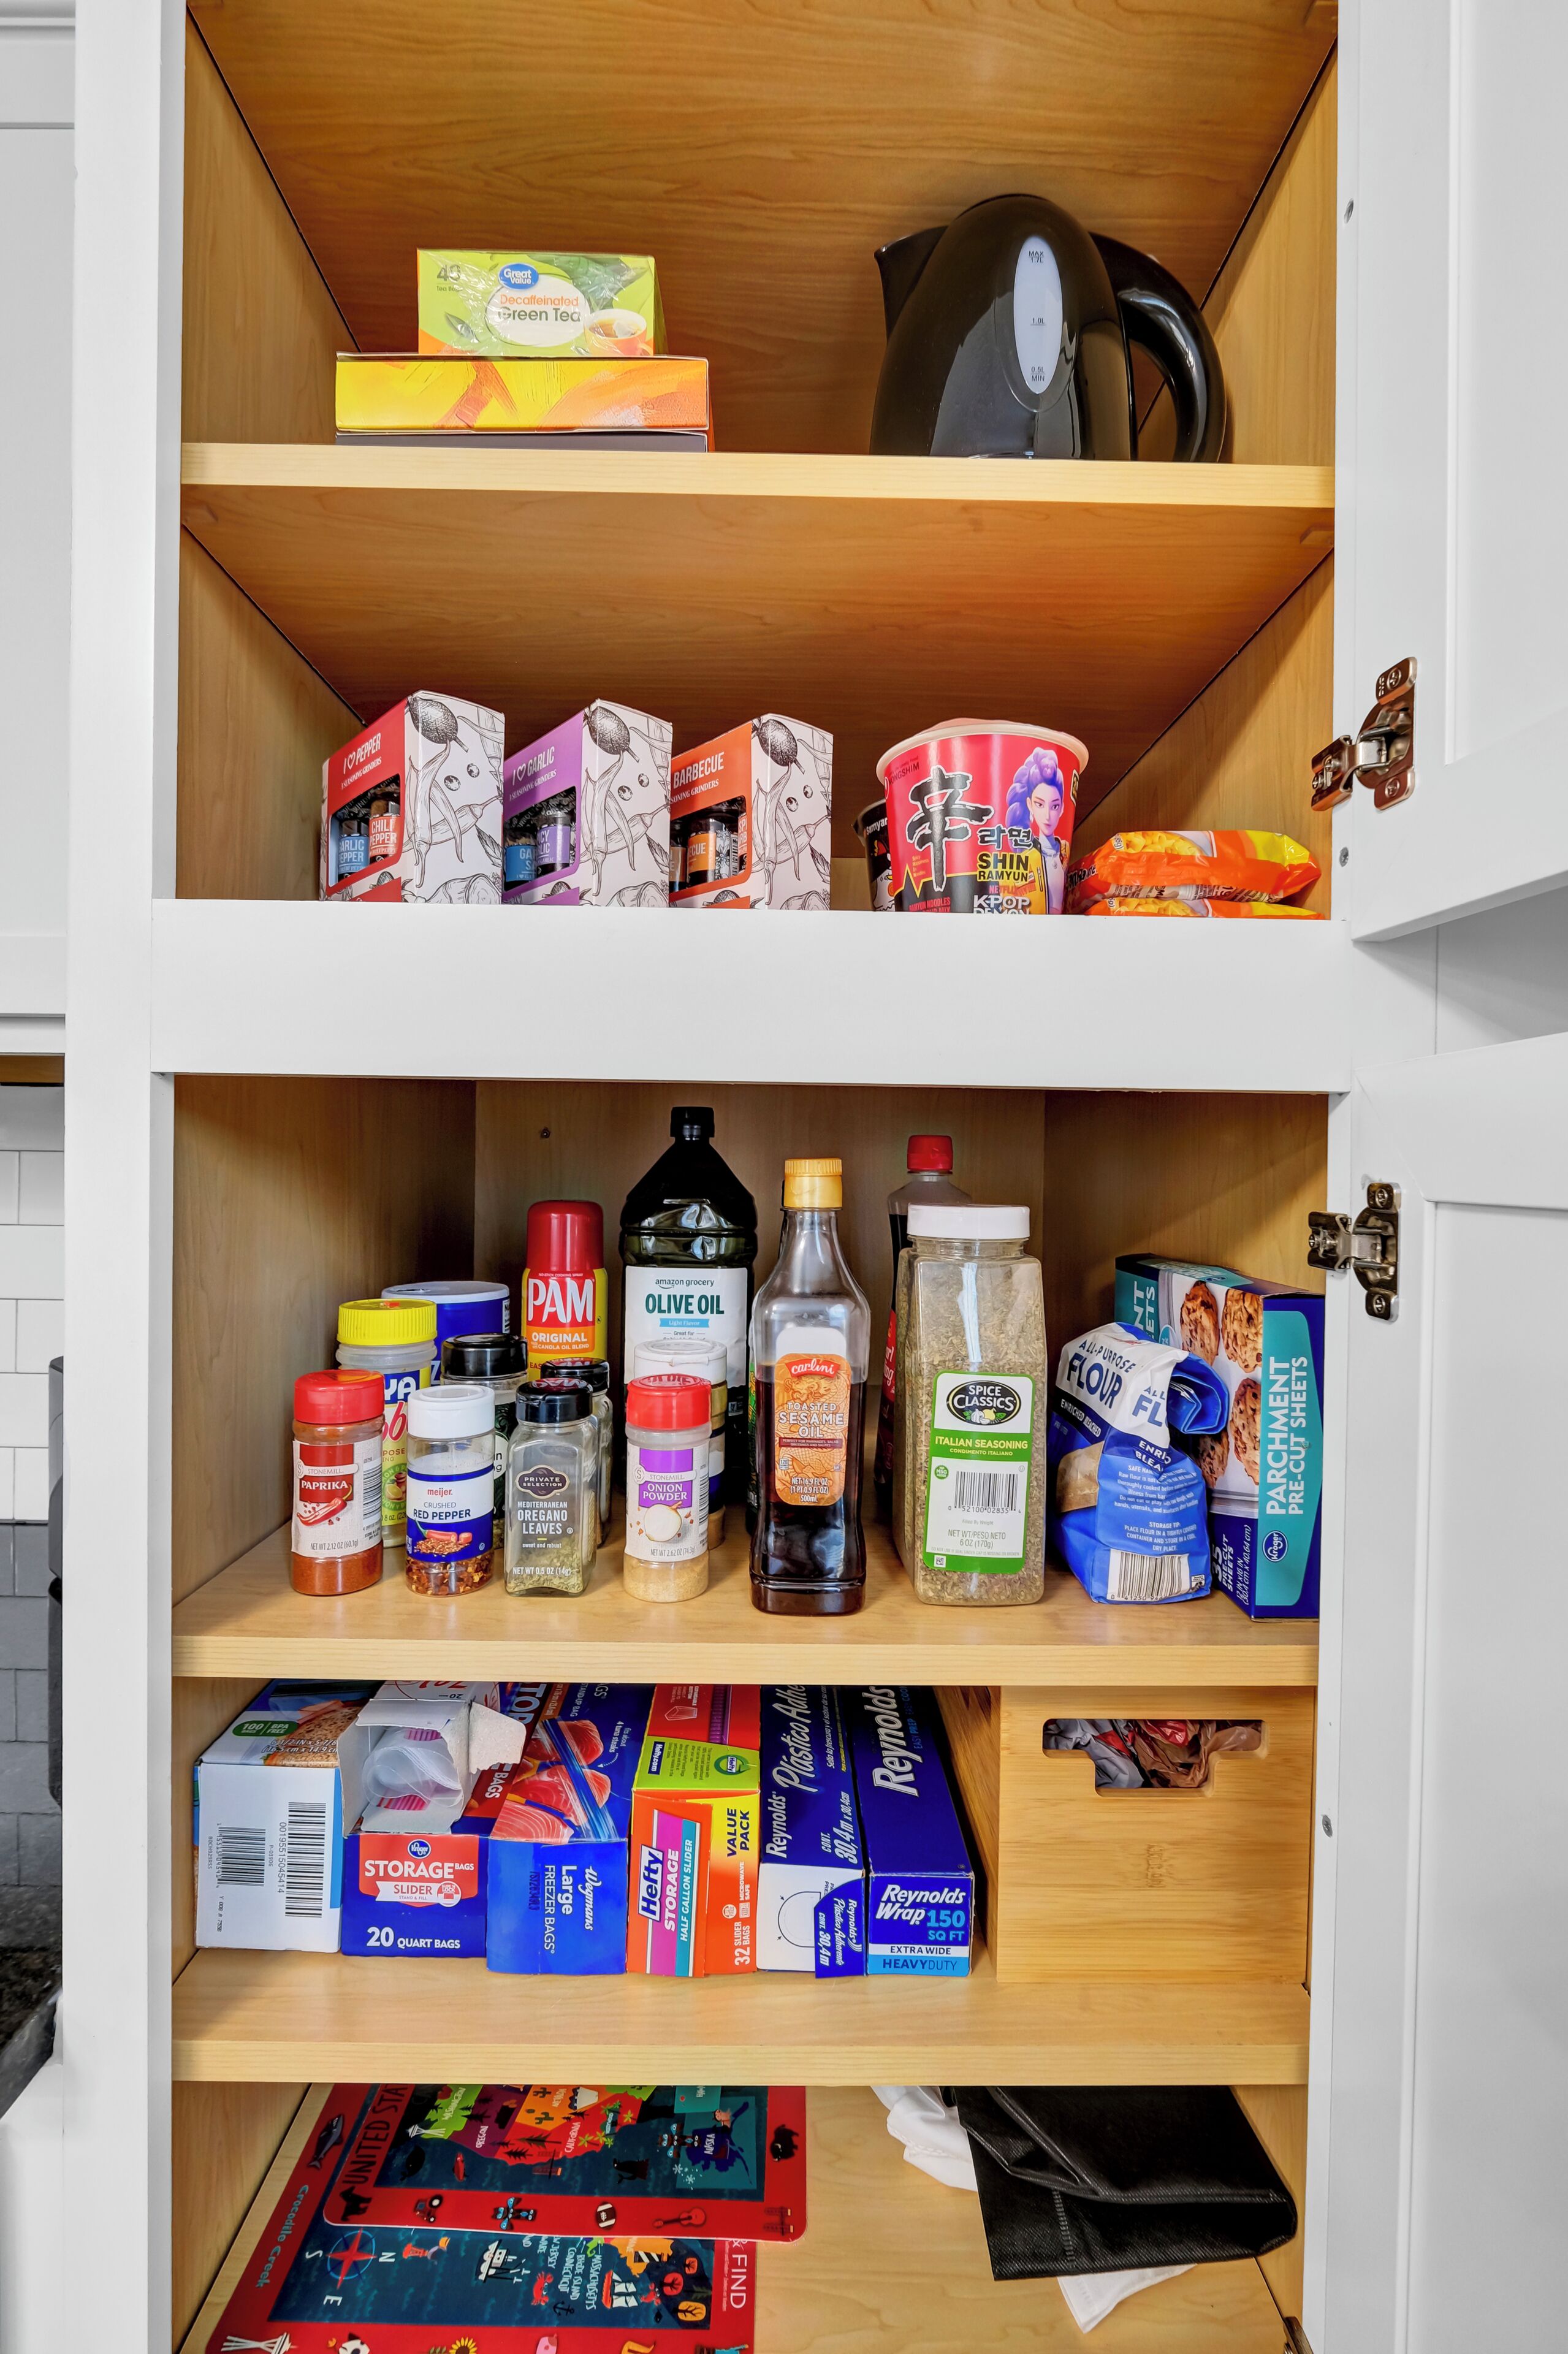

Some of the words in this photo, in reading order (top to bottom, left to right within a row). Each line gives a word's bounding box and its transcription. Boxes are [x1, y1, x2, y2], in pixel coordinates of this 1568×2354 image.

[504, 269, 531, 278] Great
[500, 294, 579, 306] Decaffeinated
[498, 307, 549, 321] Green
[553, 308, 580, 322] Tea
[356, 733, 381, 766] PEPPER
[362, 756, 382, 775] GRINDERS
[527, 746, 555, 777] GARLIC
[673, 752, 725, 789] BARBECUE
[534, 769, 557, 787] GRINDERS
[691, 779, 719, 796] GRINDERS
[371, 818, 395, 833] CHILI
[907, 765, 994, 891] 辛
[370, 832, 397, 847] PEPPER
[978, 825, 1033, 850] 라면
[978, 853, 1029, 871] SHIN
[978, 870, 1029, 882] RAMYUN
[926, 897, 951, 909] NOODLES
[528, 1278, 593, 1323] PAM
[645, 1293, 694, 1314] OLIVE
[698, 1295, 725, 1314] OIL
[532, 1332, 588, 1343] ORIGINAL
[1079, 1339, 1136, 1373] ALL-PURPOSE
[791, 1358, 835, 1376] carlini
[968, 1385, 1002, 1397] SPICE
[1067, 1352, 1123, 1409] FLOUR
[953, 1395, 1016, 1411] CLASSICS
[1289, 1356, 1307, 1429] SHEETS
[787, 1402, 837, 1411] TOASTED
[1060, 1398, 1085, 1422] ENRICHED
[778, 1412, 844, 1425] SESAME
[799, 1425, 824, 1438] OIL
[1266, 1357, 1290, 1515] PARCHMENT
[935, 1436, 973, 1447] ITALIAN
[974, 1439, 1028, 1450] SEASONING
[301, 1480, 348, 1490] PAPRIKA
[1117, 1479, 1142, 1490] thoroughly
[1288, 1438, 1306, 1515] PRE-CUT
[427, 1487, 452, 1498] meijer
[643, 1491, 687, 1501] POWDER
[647, 1483, 683, 1492] ONION
[413, 1509, 429, 1519] RED
[432, 1509, 471, 1520] PEPPER
[517, 1510, 568, 1522] OREGANO
[522, 1523, 562, 1534] LEAVES
[961, 1530, 989, 1539] WT/PESO
[1127, 1533, 1152, 1542] CONTAINER
[1182, 1524, 1197, 1533] COVERED
[344, 1539, 359, 1550] (60.1g)
[683, 1545, 696, 1556] (74.3g)
[975, 1540, 994, 1549] (170g)
[1268, 1533, 1283, 1560] Kroger
[555, 1567, 571, 1577] (14g)
[1212, 1545, 1223, 1582] 35
[907, 1718, 919, 1734] PREP
[609, 1735, 619, 1753] steaks
[862, 1685, 923, 1797] Reynolds
[651, 1743, 663, 1772] Hefty.com
[727, 1756, 736, 1773] Hefty
[772, 1733, 818, 1793] Plástico
[485, 1772, 506, 1799] BAGS
[727, 1808, 737, 1857] VALUE
[739, 1810, 750, 1851] PACK
[766, 1793, 792, 1859] Reynolds
[411, 1842, 428, 1856] Kroger
[684, 1840, 693, 1874] SLIDER
[365, 1860, 454, 1879] STORAGE
[394, 1884, 432, 1895] SLIDER
[544, 1865, 555, 1914] FREEZER
[557, 1865, 577, 1915] Large
[641, 1850, 663, 1916] Hefty
[664, 1848, 679, 1932] STORAGE
[577, 1865, 603, 1931] Wegmans
[682, 1876, 691, 1914] GALLON
[882, 1884, 965, 1905] Reynolds
[834, 1897, 846, 1929] Plástico
[847, 1899, 858, 1941] Reynolds
[875, 1902, 925, 1925] Wrap
[927, 1910, 965, 1927] 150
[367, 1927, 395, 1947] 20
[397, 1938, 432, 1949] QUART
[435, 1939, 460, 1949] BAGS
[544, 1917, 555, 1950] BAGS
[928, 1931, 948, 1941] SQ
[950, 1931, 965, 1941] FT
[734, 1946, 750, 1966] 32
[818, 1930, 831, 1966] 30,4m
[834, 1928, 846, 1966] Adherente
[890, 1945, 923, 1956] EXTRA
[925, 1946, 951, 1956] WIDE
[442, 2087, 466, 2120] WASHINGTON
[552, 2088, 567, 2108] NEVADA
[476, 2125, 489, 2148] OREGON
[565, 2121, 581, 2153] CALIFORNIA
[343, 2120, 390, 2184] UNITED
[278, 2185, 308, 2242] Crocodile
[255, 2245, 281, 2288] Creek
[558, 2247, 577, 2293] CONNECTICUT
[569, 2276, 582, 2300] ISLAND
[585, 2254, 603, 2310] MASSACHUSETTS
[730, 2254, 747, 2309] FIND
[323, 2295, 343, 2306] E
